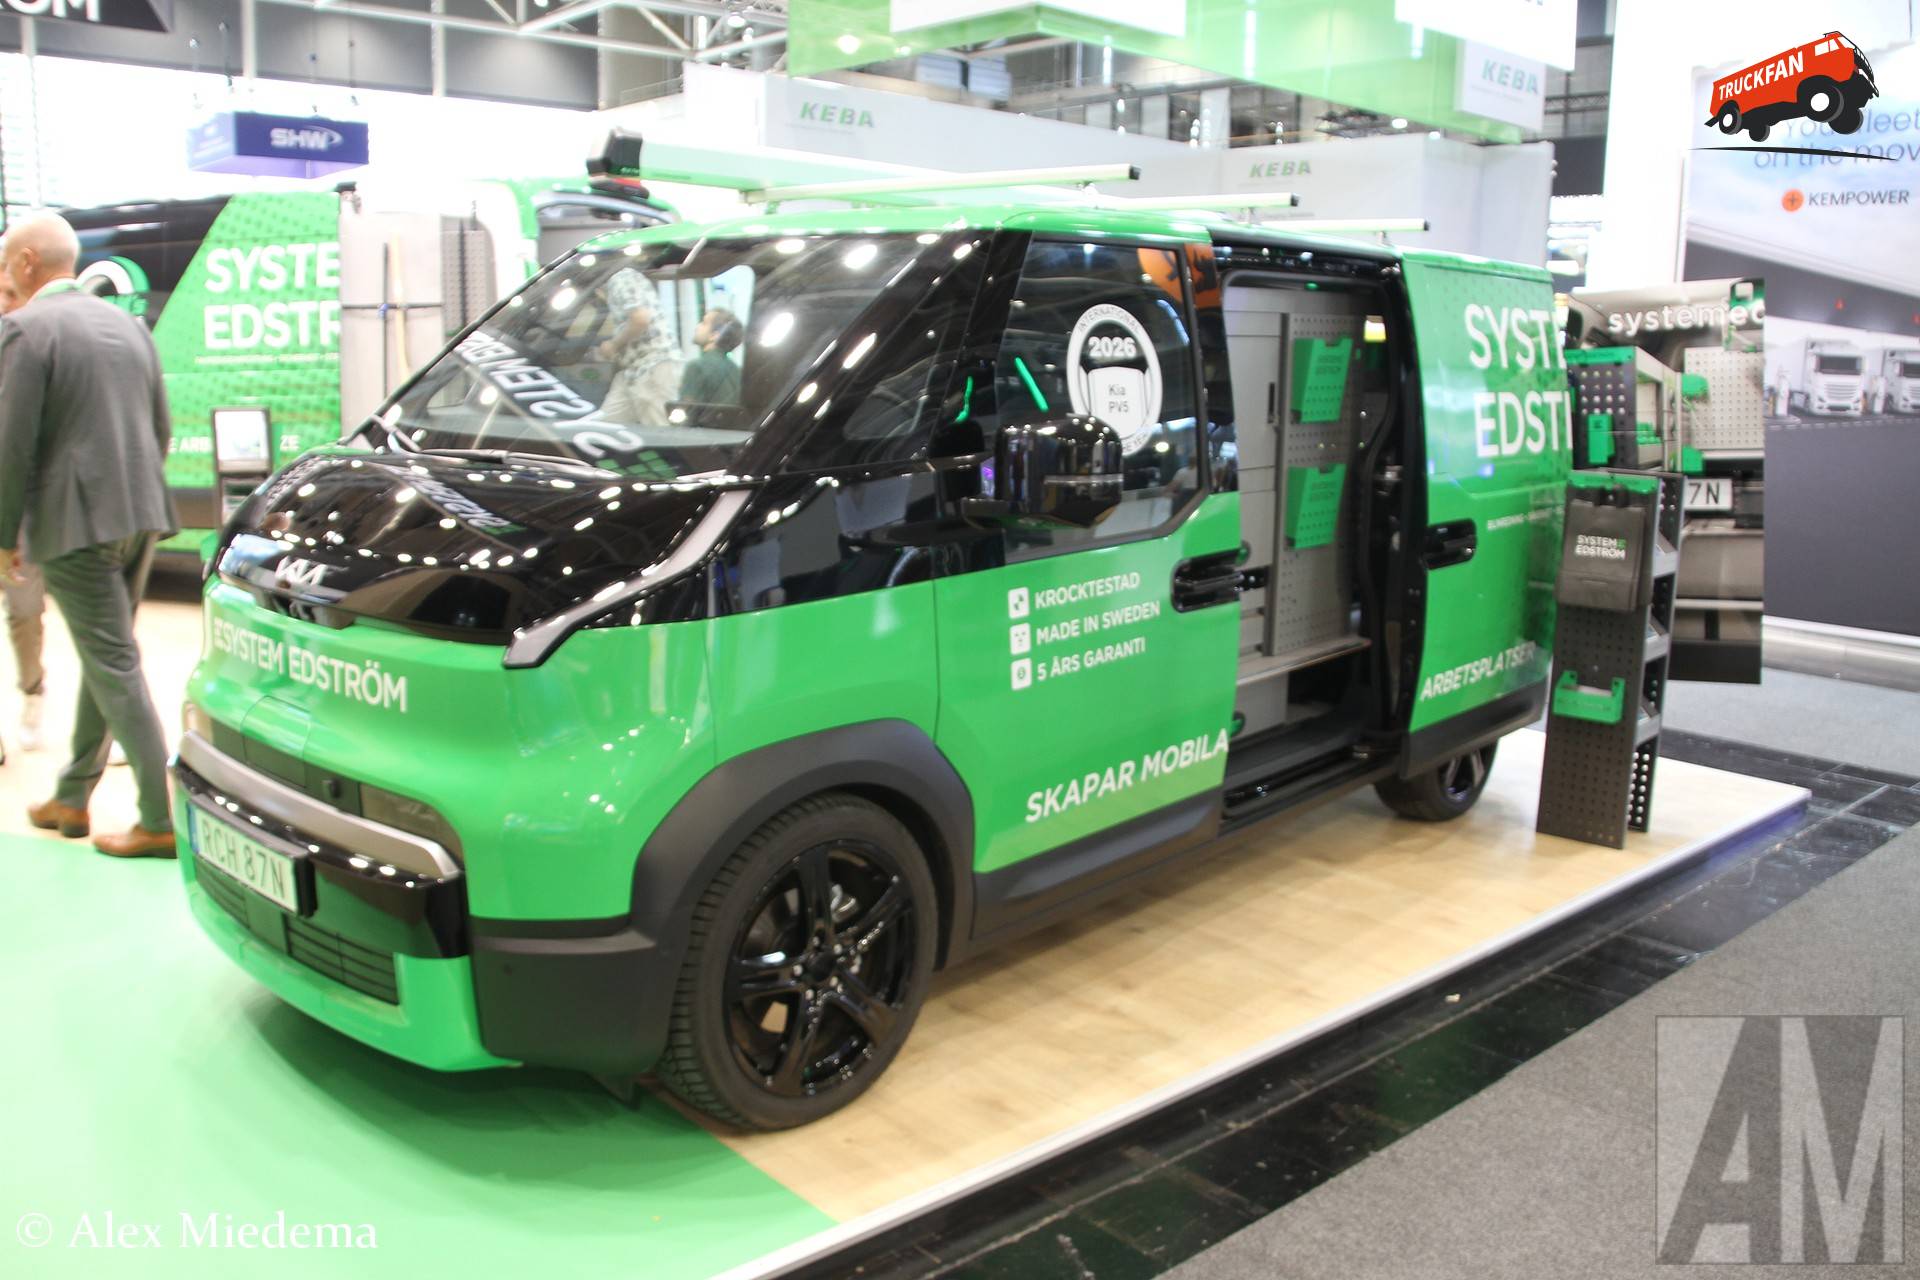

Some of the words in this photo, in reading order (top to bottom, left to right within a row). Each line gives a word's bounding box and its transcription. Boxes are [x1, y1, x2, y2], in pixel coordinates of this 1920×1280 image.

[1482, 59, 1539, 96] KEBA
[800, 101, 875, 129] KEBA
[270, 128, 328, 151] SHW
[1249, 160, 1312, 178] KEBA
[1808, 190, 1911, 207] KEMPOWER
[1087, 336, 1137, 359] 2026
[1109, 383, 1127, 397] Kia
[1108, 400, 1129, 414] PV5
[1577, 534, 1617, 548] SYSTEM
[1034, 571, 1141, 610] KROCKTESTAD
[1036, 618, 1081, 646] MADE
[1083, 614, 1100, 634] IN
[1101, 599, 1161, 630] SWEDEN
[1036, 661, 1048, 682] 5
[1050, 653, 1081, 678] ÅRS
[1083, 636, 1147, 669] GARANTI
[1420, 640, 1537, 702] ARBETSPLATSER
[288, 645, 408, 714] EDSTRÖM
[1025, 760, 1136, 823] SKAPAR
[1140, 727, 1230, 782] MOBILA
[202, 818, 240, 874] RCH
[243, 842, 286, 900] 87N
